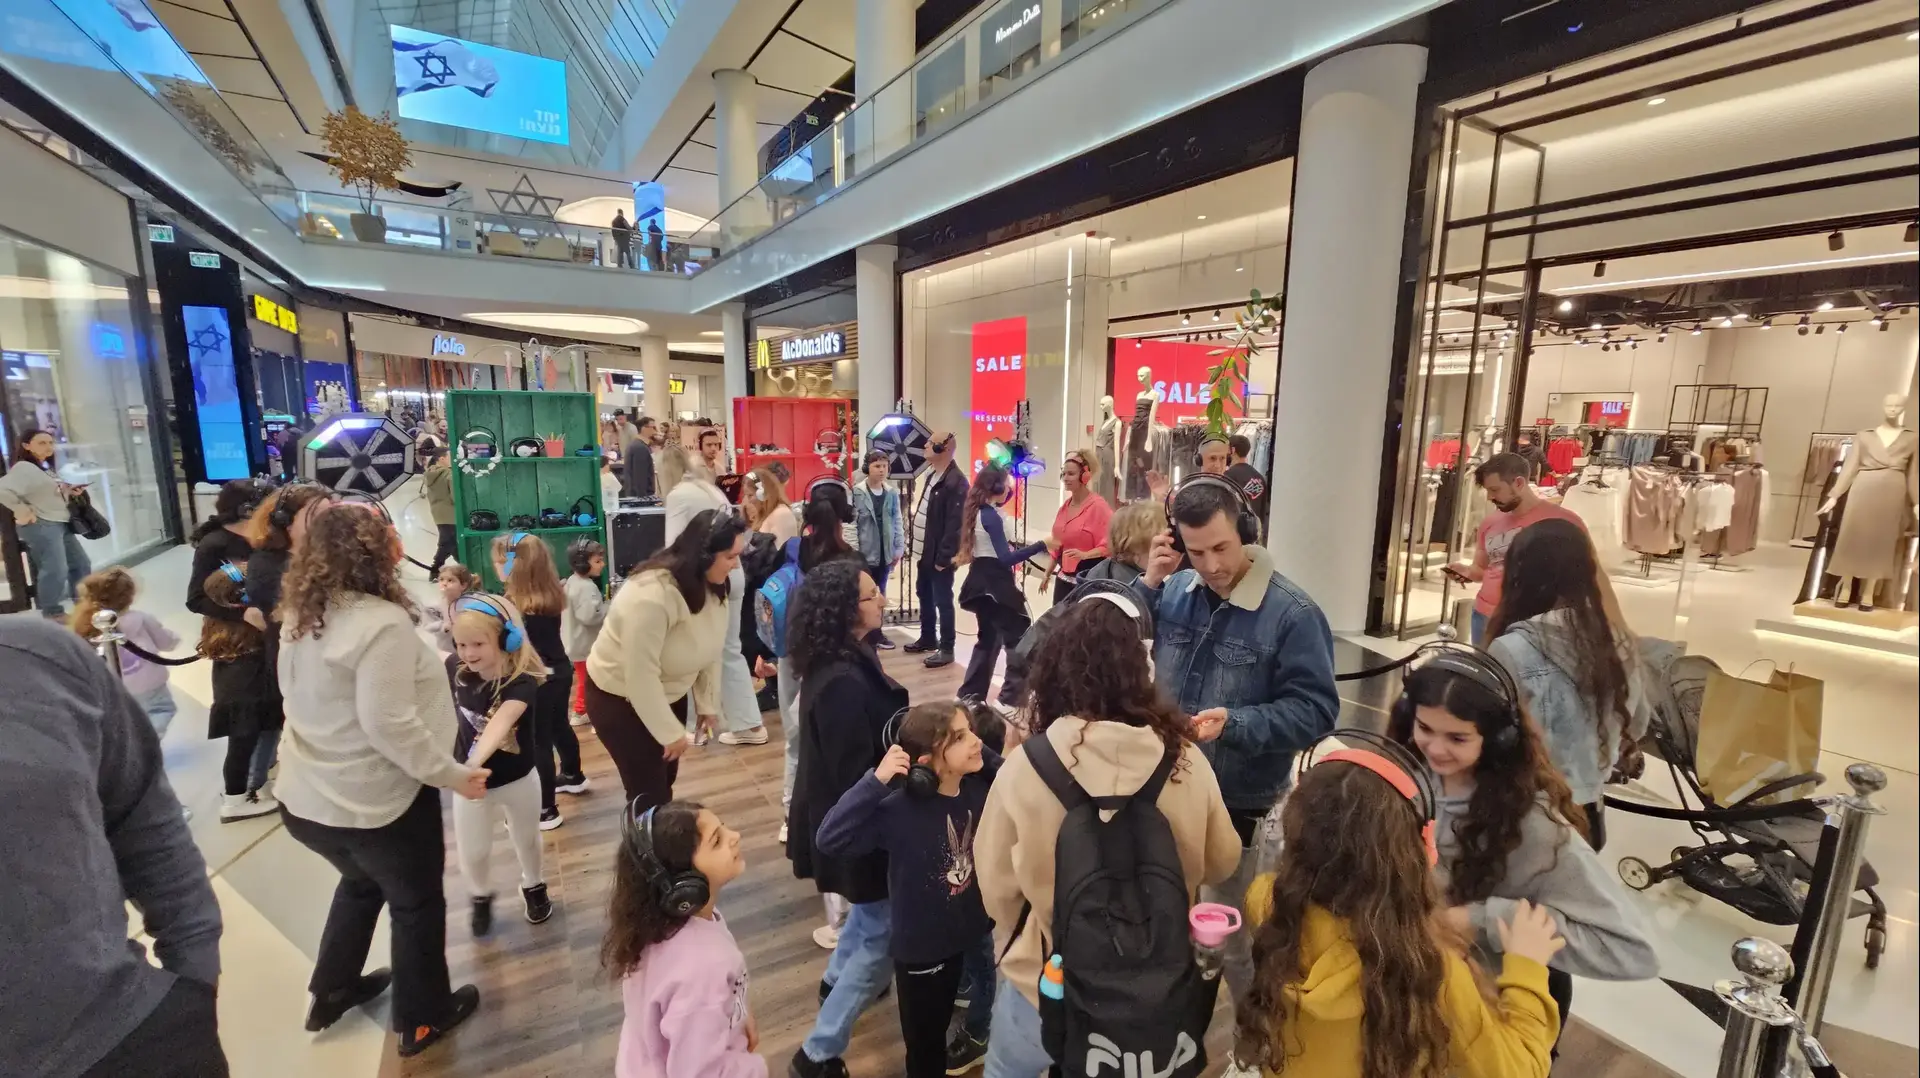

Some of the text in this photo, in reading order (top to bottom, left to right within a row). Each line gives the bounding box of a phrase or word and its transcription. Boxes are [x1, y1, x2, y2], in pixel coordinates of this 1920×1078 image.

[533, 109, 561, 123] יחד
[782, 331, 840, 360] McDonald's
[975, 354, 1023, 373] SALE
[1153, 380, 1212, 404] SALE
[1602, 400, 1623, 415] SALE
[975, 414, 1016, 423] RESERVE
[1085, 1031, 1198, 1078] FILA
